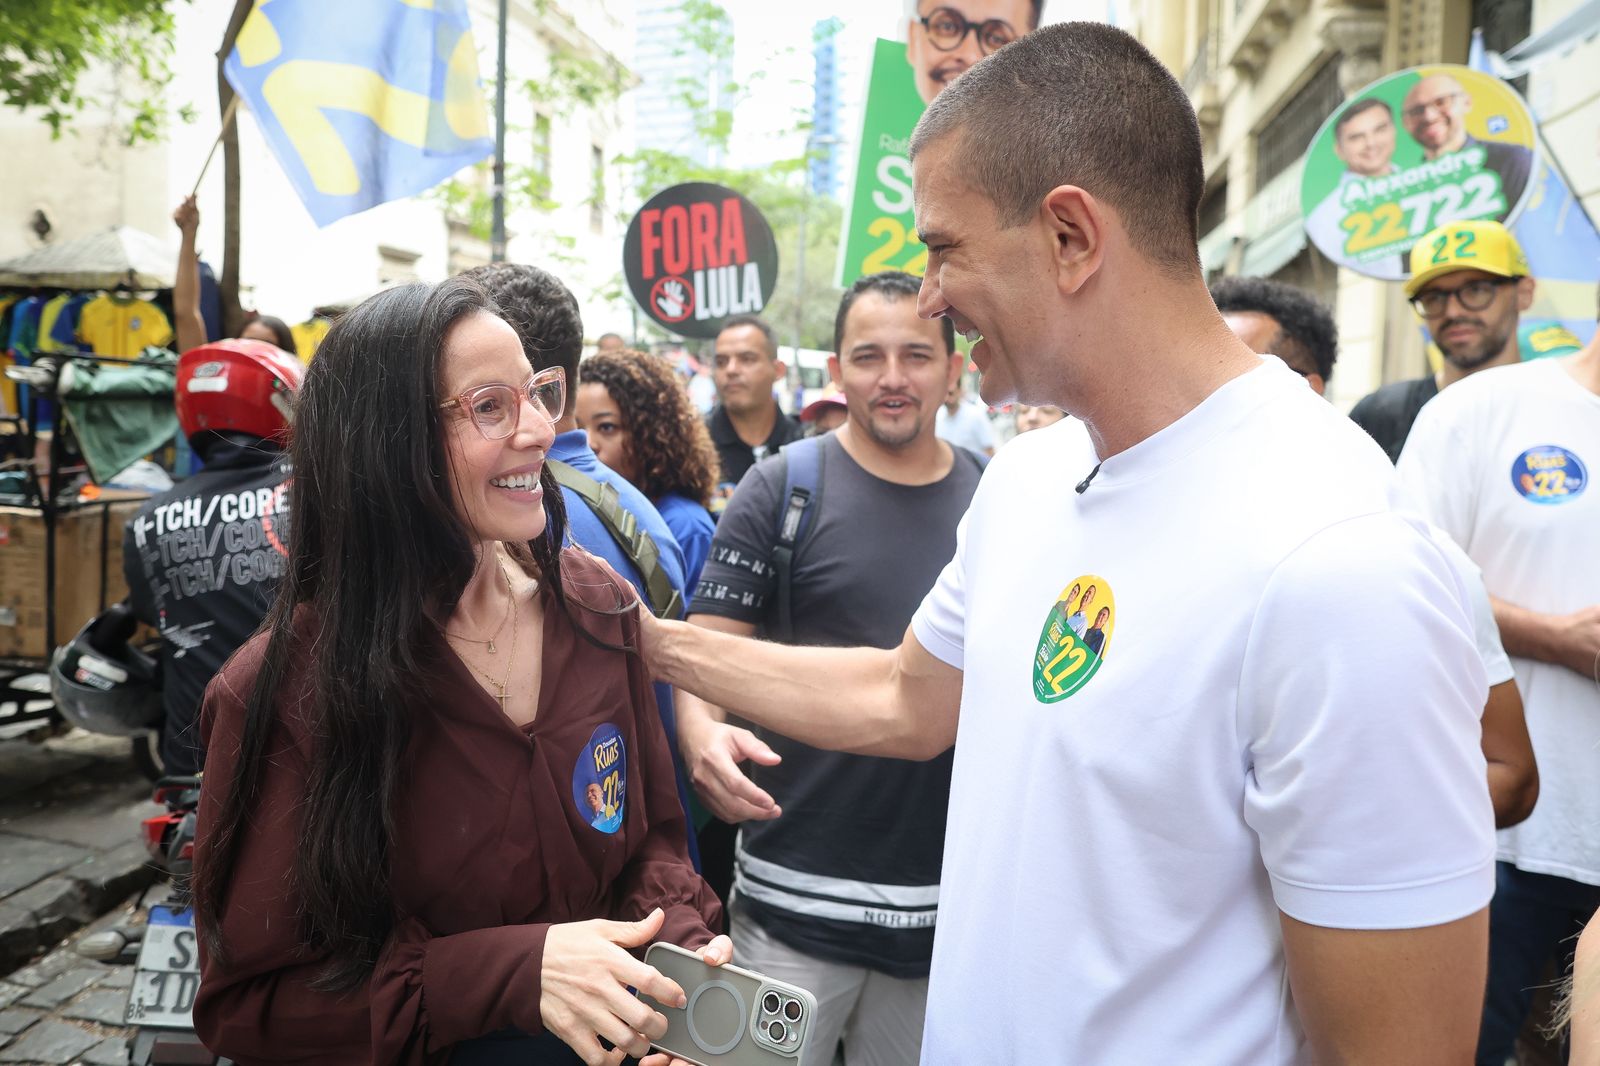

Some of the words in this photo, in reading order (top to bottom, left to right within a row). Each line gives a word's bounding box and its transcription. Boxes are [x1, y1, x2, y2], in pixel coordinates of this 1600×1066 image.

[872, 155, 914, 214] S
[1344, 146, 1487, 205] Alexandre
[640, 197, 748, 280] FORA
[1342, 172, 1506, 254] 22722
[1432, 230, 1477, 264] 22
[693, 261, 763, 321] LULA
[1534, 468, 1569, 496] 22
[1042, 635, 1088, 695] 22
[593, 742, 620, 772] Ruas
[603, 769, 620, 819] 22
[168, 930, 199, 970] S
[144, 972, 199, 1014] 1D
